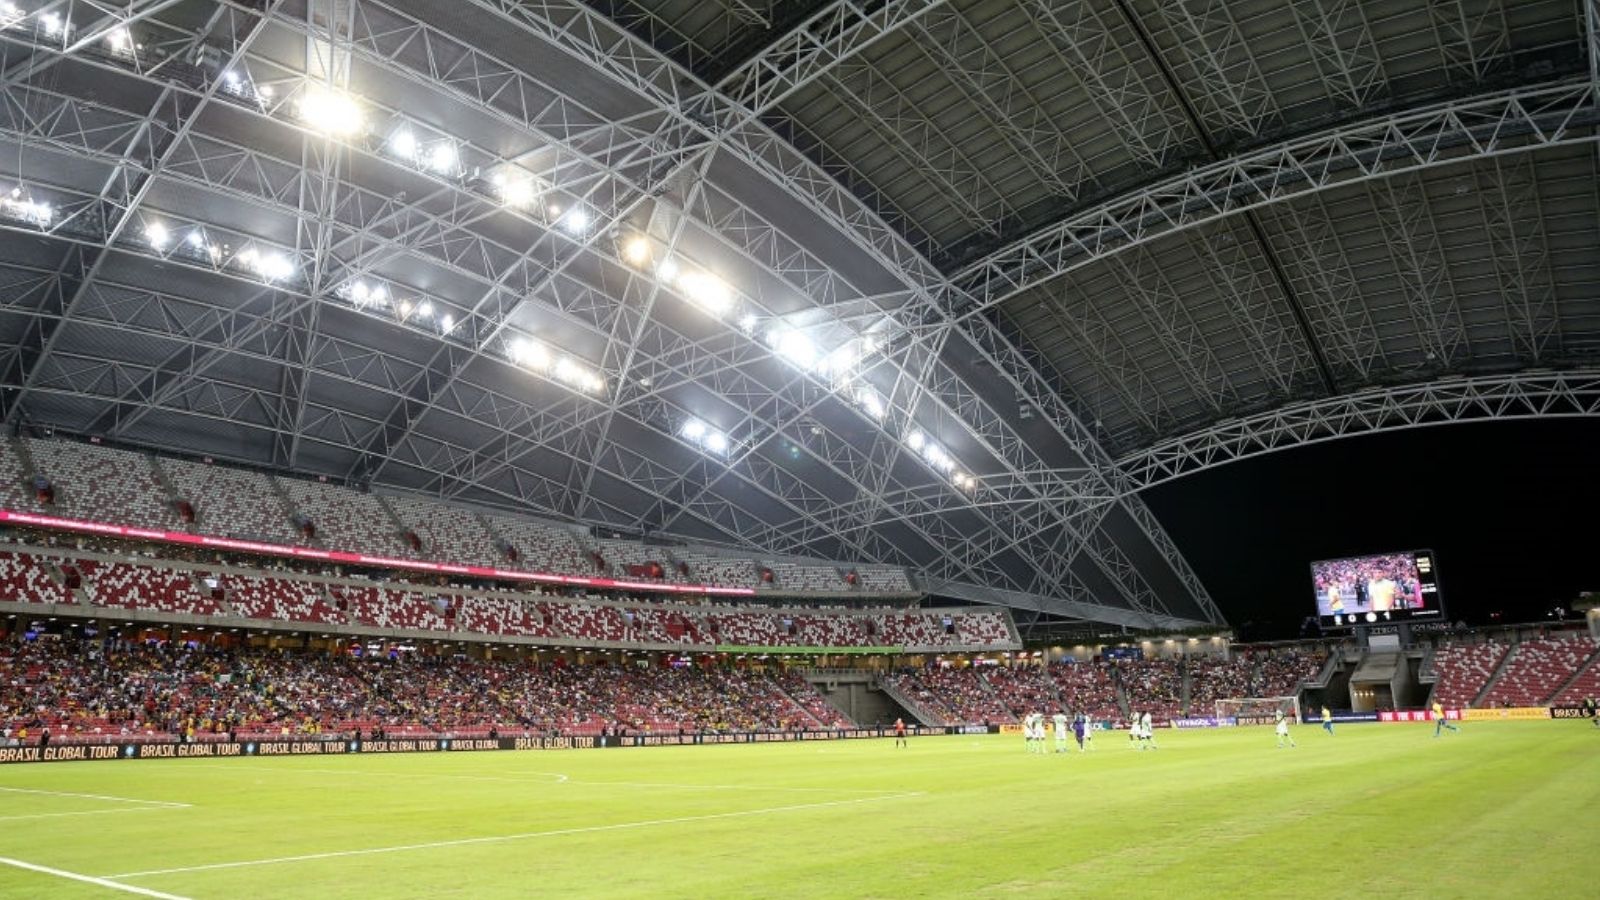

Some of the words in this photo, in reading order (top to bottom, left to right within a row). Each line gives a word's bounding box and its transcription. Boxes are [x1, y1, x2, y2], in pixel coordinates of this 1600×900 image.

[1554, 709, 1581, 718] BRASIL
[260, 743, 290, 754] BRASIL
[291, 743, 322, 754] GLOBAL
[325, 741, 346, 753] TOUR
[361, 741, 388, 752] BRASIL
[389, 741, 416, 751] GLOBAL
[419, 740, 438, 751] TOUR
[515, 738, 543, 750] BRASIL
[544, 737, 573, 749] GLOBAL
[574, 736, 595, 749] TOUR
[0, 748, 41, 761] BRASIL
[44, 746, 87, 760] GLOBAL
[89, 745, 119, 759] TOUR
[141, 745, 176, 757] BRASIL
[178, 744, 214, 756] GLOBAL
[217, 743, 241, 755] TOUR
